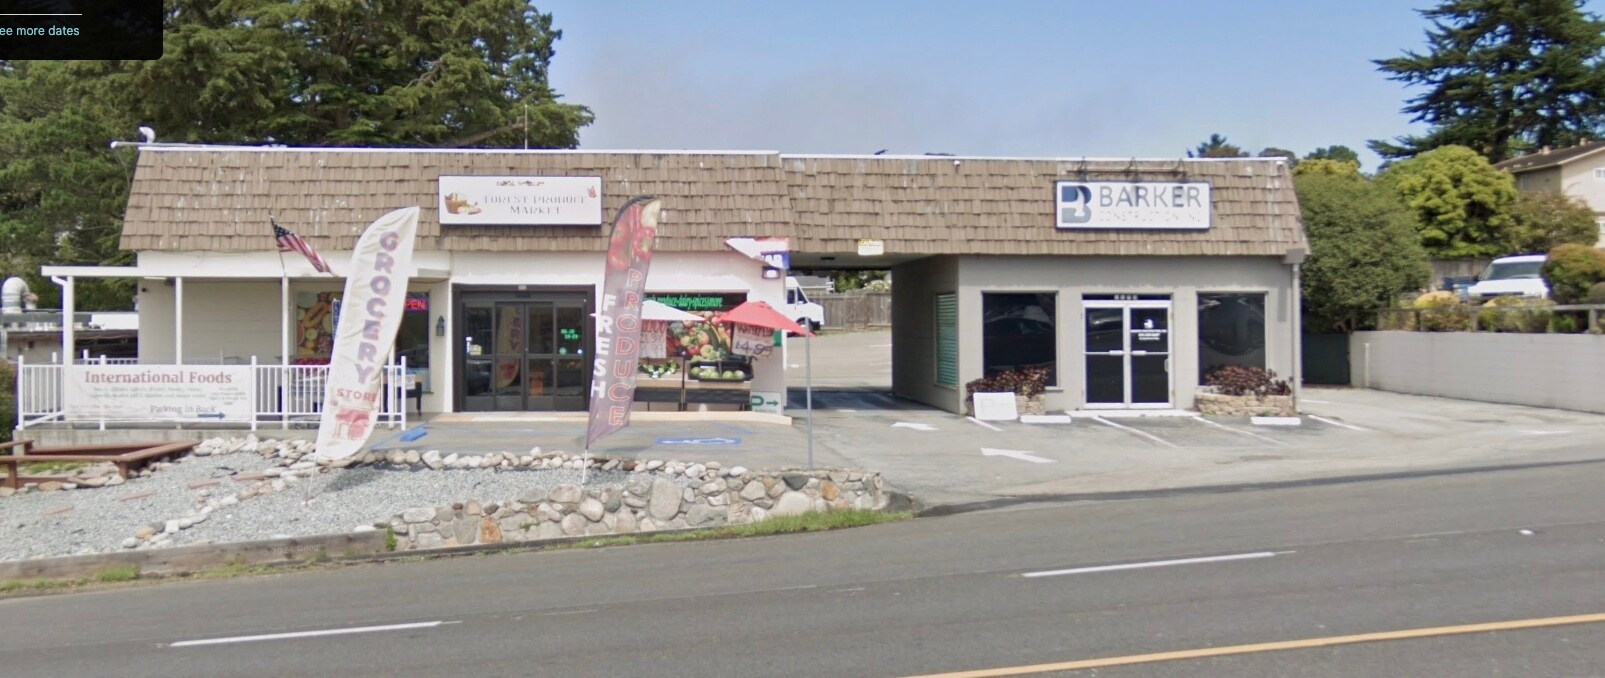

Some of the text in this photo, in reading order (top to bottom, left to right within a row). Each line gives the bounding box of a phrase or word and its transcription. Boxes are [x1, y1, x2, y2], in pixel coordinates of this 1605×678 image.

[1099, 185, 1202, 208] BARKER
[510, 205, 561, 215] MARKET
[354, 231, 400, 386] GROCERY
[404, 298, 427, 310] PEN
[591, 293, 617, 399] FRESH
[608, 268, 643, 427] PRODUCE
[84, 370, 233, 384] International Foods
[150, 404, 217, 416] Parking in Back
